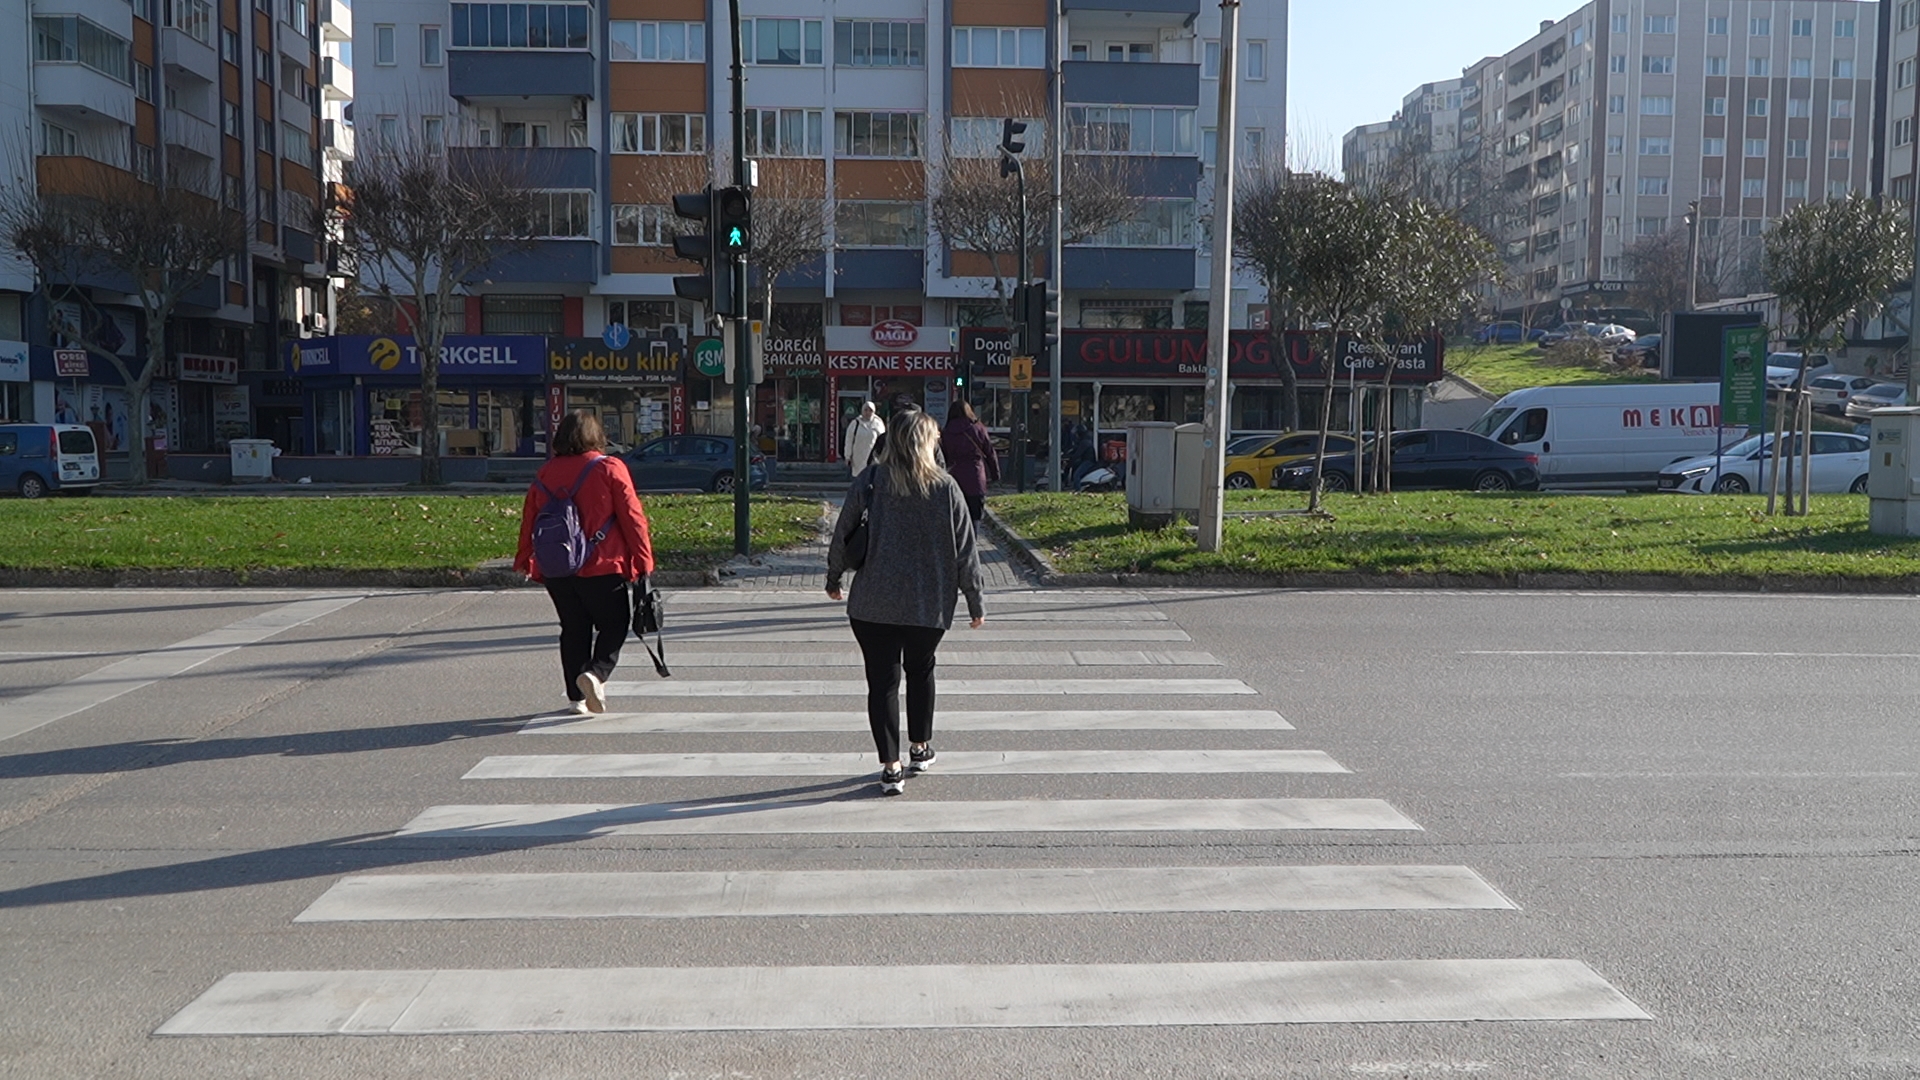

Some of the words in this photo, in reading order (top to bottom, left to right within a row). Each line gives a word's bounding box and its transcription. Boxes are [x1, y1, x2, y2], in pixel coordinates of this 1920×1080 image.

[875, 329, 915, 341] DAĞLI
[765, 336, 817, 352] BÖREĞİ
[406, 346, 518, 365] TRKCELL
[551, 350, 571, 371] bi
[579, 350, 629, 371] dolu
[697, 347, 724, 368] FSM
[763, 354, 822, 366] BAKLAVA
[828, 355, 900, 370] KESTANE
[1396, 358, 1426, 369] asta
